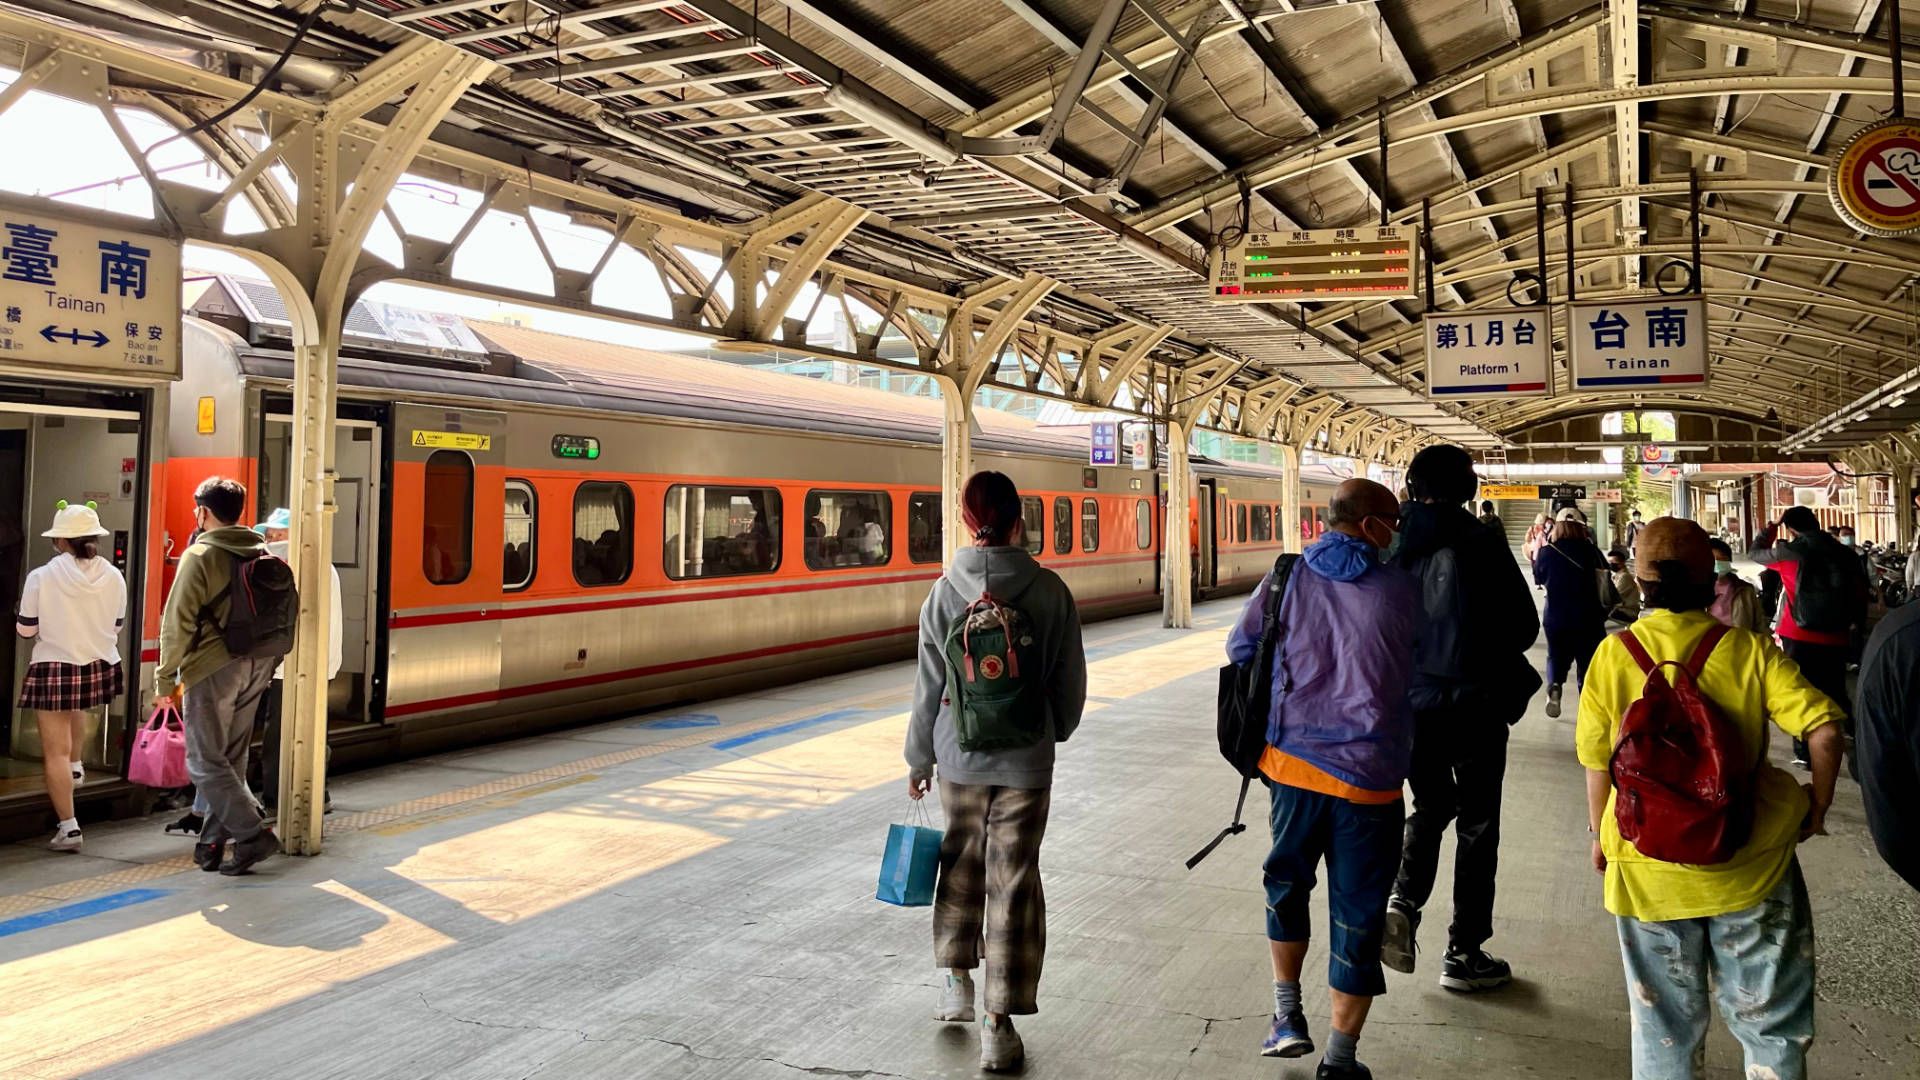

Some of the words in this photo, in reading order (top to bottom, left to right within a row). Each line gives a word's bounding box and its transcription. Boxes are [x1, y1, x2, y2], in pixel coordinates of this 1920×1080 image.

[1336, 229, 1355, 238] 時間
[2, 222, 151, 300] 臺南
[1221, 261, 1237, 269] 月台
[44, 290, 106, 315] Tainan
[125, 321, 163, 341] 保安
[1436, 318, 1537, 349] 第1月台
[1589, 306, 1688, 350] 台南
[1459, 362, 1509, 376] Platform
[1513, 362, 1519, 374] 1
[1607, 357, 1670, 370] Tainan
[1135, 443, 1144, 456] 3
[1551, 487, 1559, 498] 2
